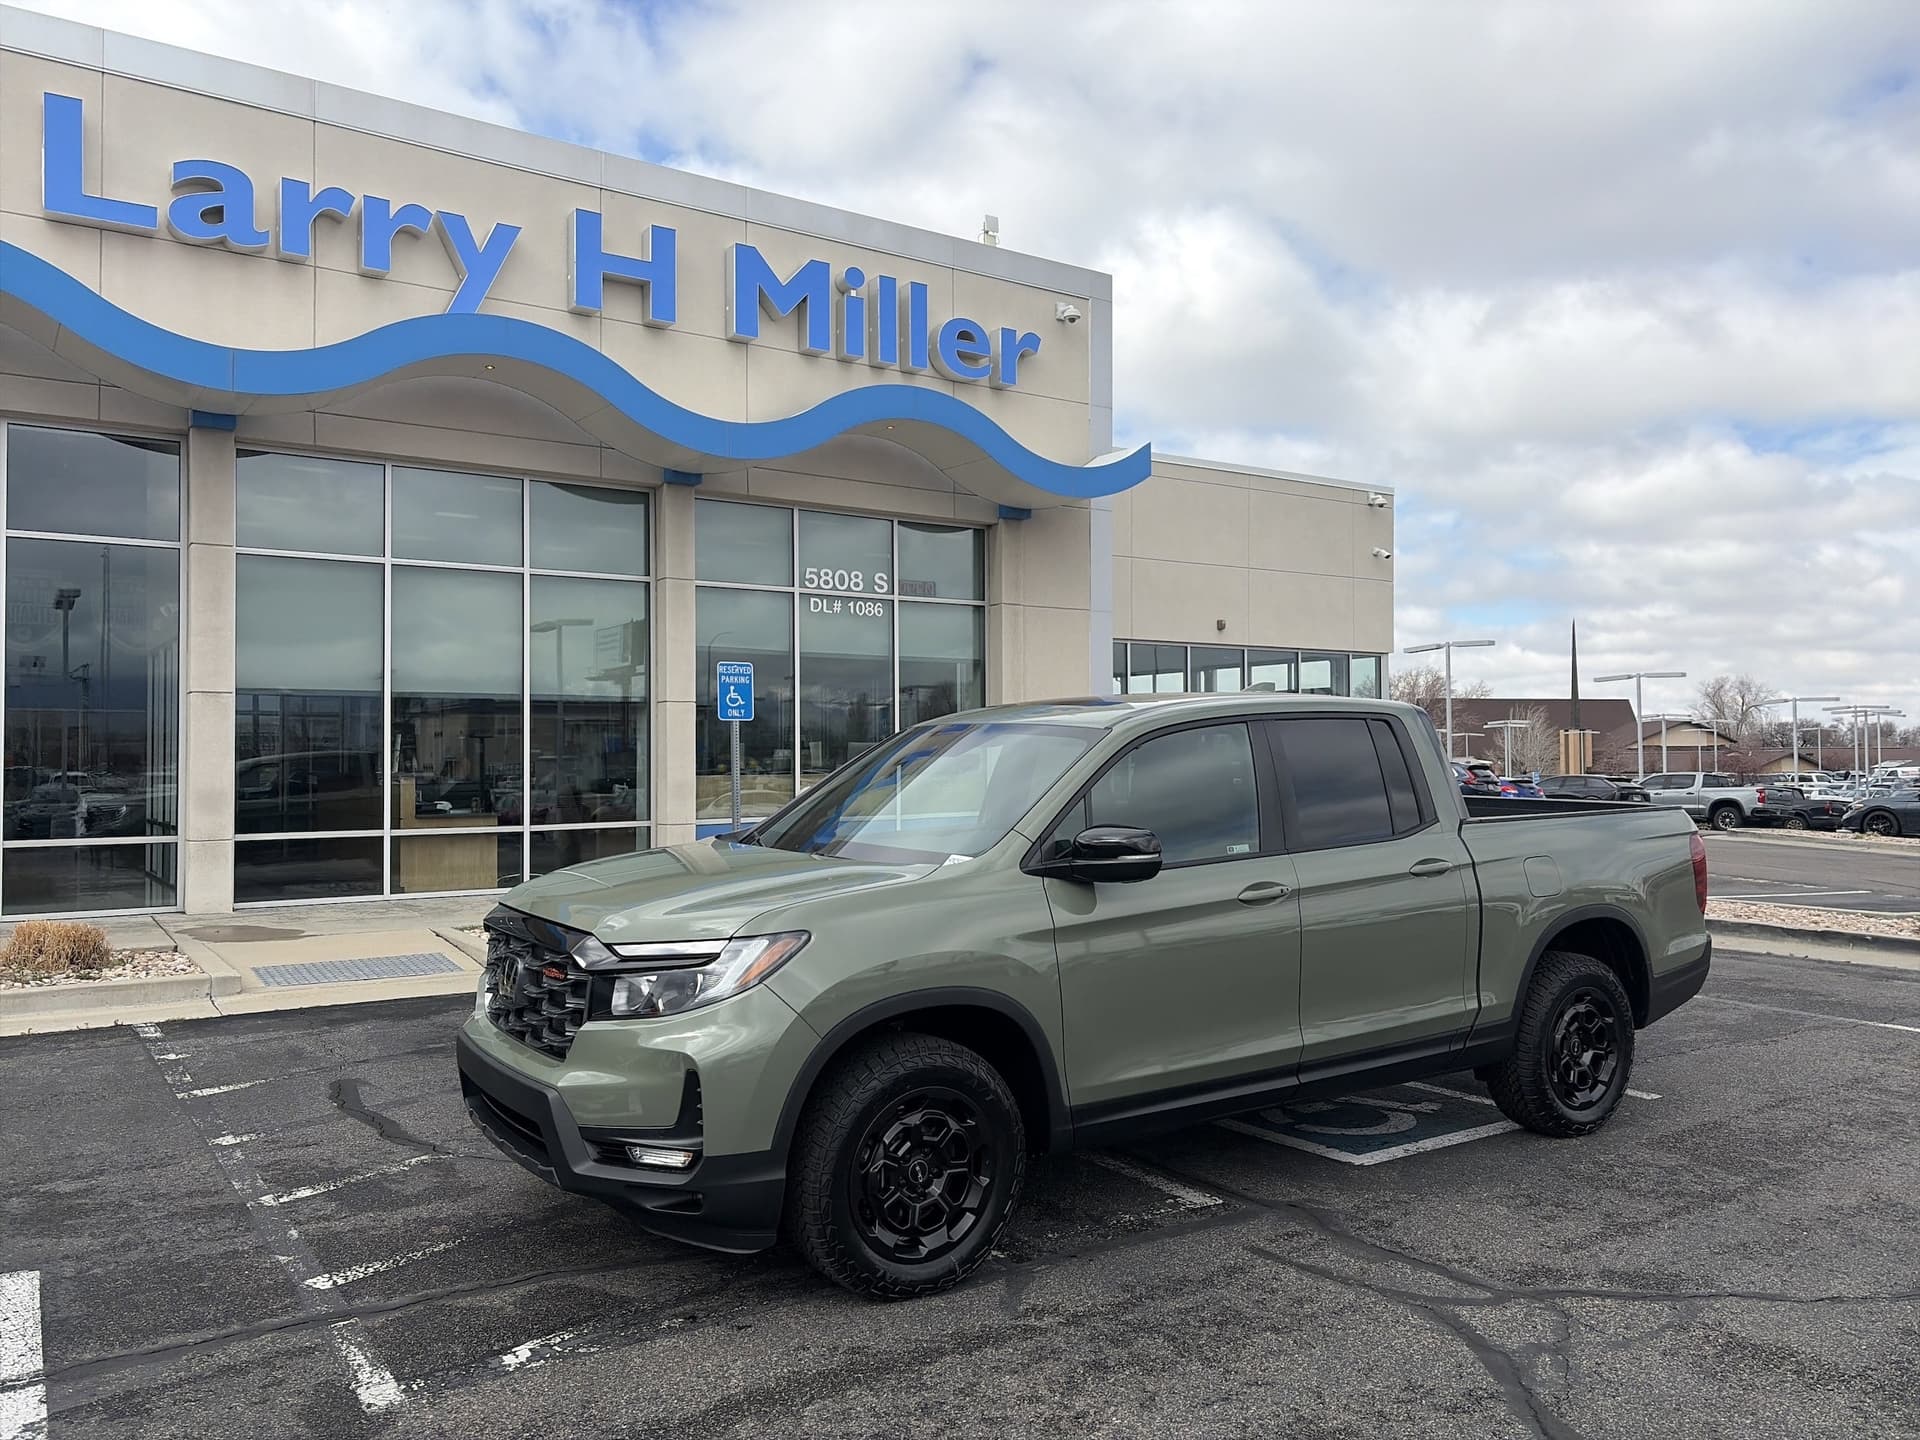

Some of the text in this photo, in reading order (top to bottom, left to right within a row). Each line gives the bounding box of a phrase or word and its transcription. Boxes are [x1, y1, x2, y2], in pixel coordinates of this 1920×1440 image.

[42, 91, 1042, 390] Larry H Miller
[804, 567, 864, 592] 5808
[873, 572, 889, 594] S
[810, 597, 884, 617] DL# 1086
[719, 665, 752, 675] RESERVED
[721, 675, 750, 684] PARKING
[727, 708, 745, 717] ONLY
